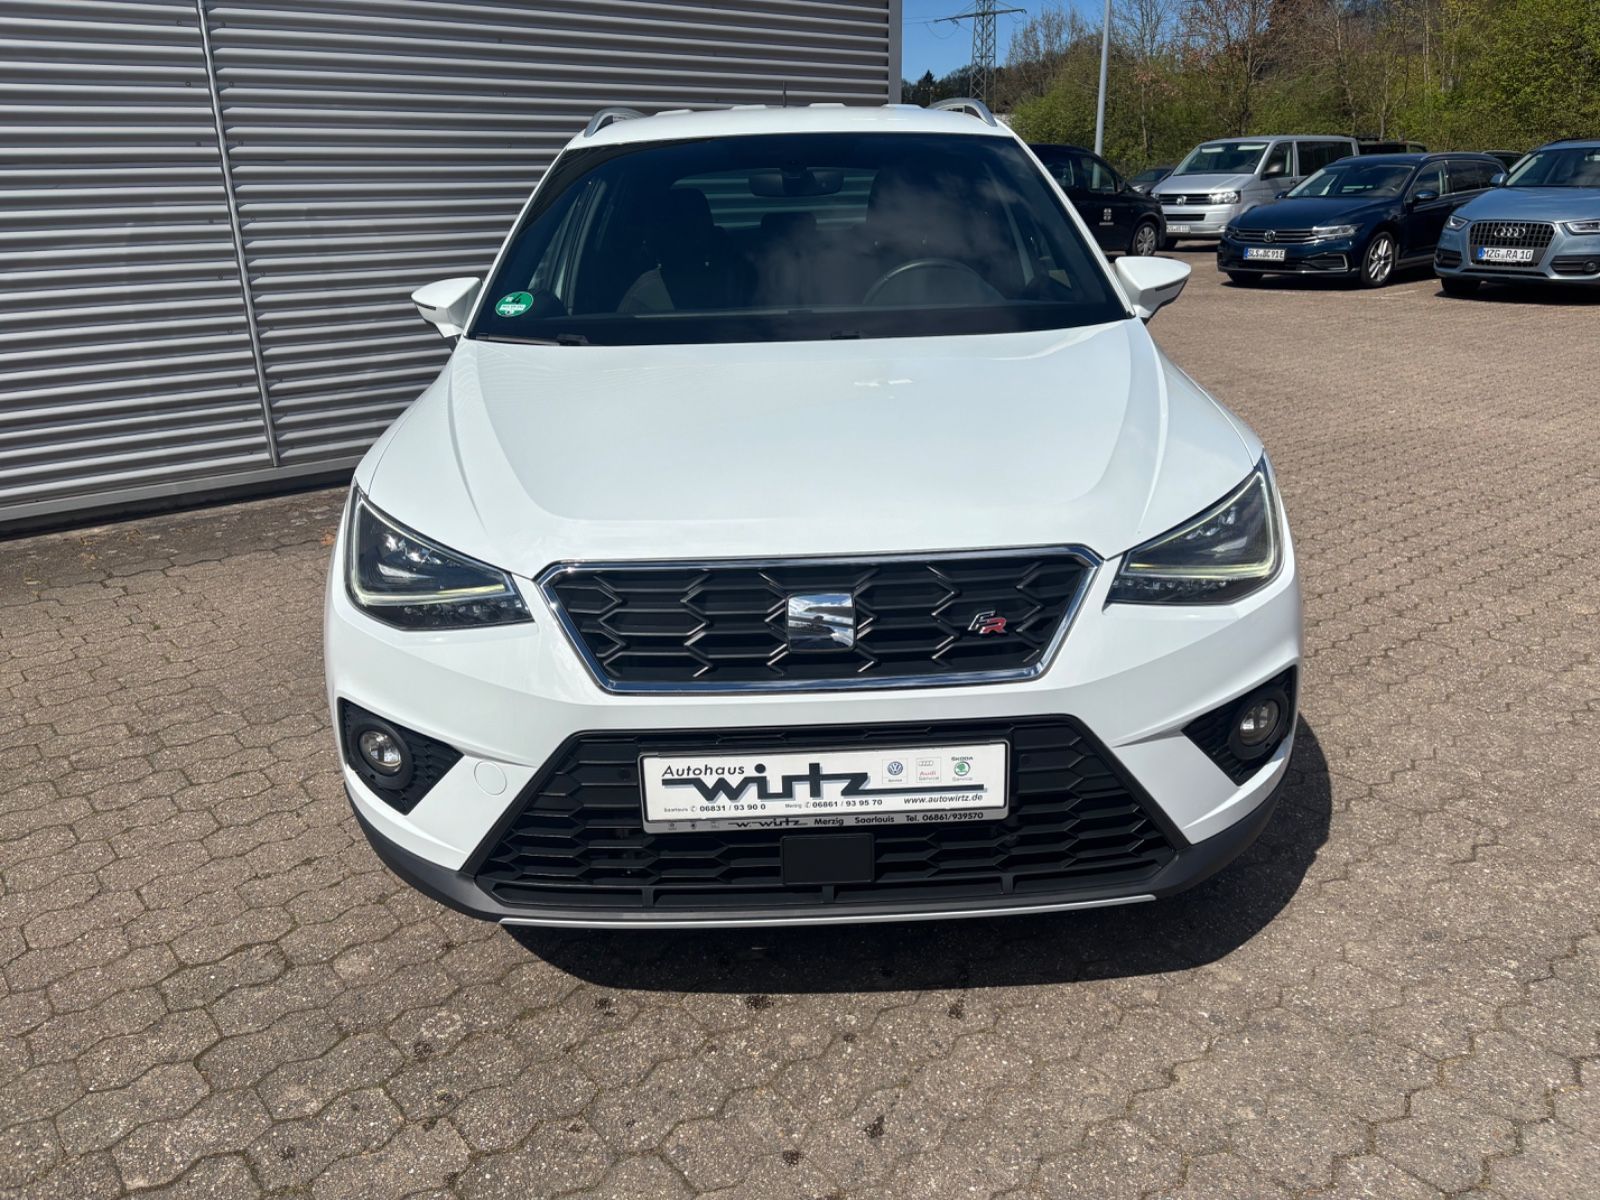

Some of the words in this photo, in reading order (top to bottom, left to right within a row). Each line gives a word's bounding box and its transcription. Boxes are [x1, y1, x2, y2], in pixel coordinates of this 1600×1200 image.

[1505, 249, 1518, 259] RA
[1520, 250, 1532, 259] 10
[662, 764, 745, 777] Autohaus
[904, 793, 984, 804] www.autowirtz.de
[699, 804, 726, 812] 06831
[734, 804, 745, 812] 93
[747, 803, 758, 811] 90
[812, 801, 838, 809] 06861
[814, 817, 844, 826] Merzig
[854, 815, 895, 824] Saarlouis
[905, 814, 919, 822] Tel.
[922, 811, 984, 821] 06861/939570
